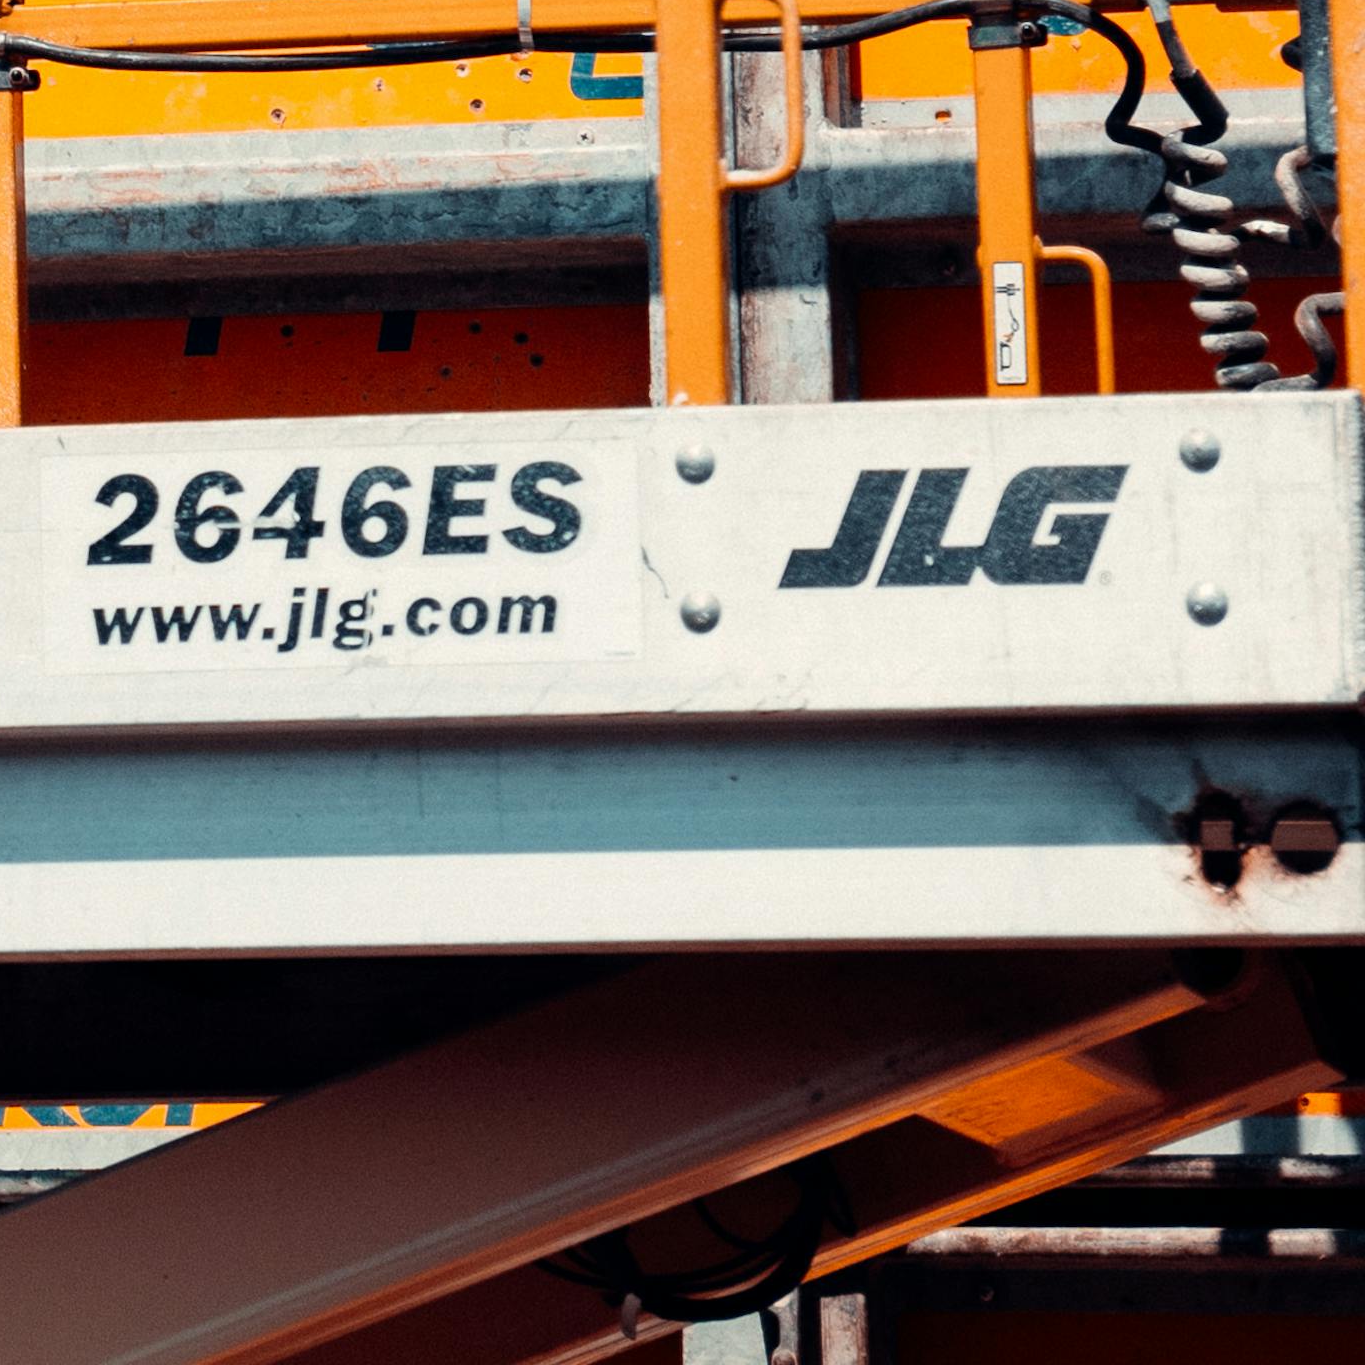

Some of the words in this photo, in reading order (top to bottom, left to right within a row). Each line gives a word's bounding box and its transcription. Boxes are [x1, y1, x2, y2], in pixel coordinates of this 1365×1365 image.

[86, 461, 587, 566] 2646ES
[778, 465, 1130, 588] JLG
[92, 585, 558, 653] www.jlg.com
